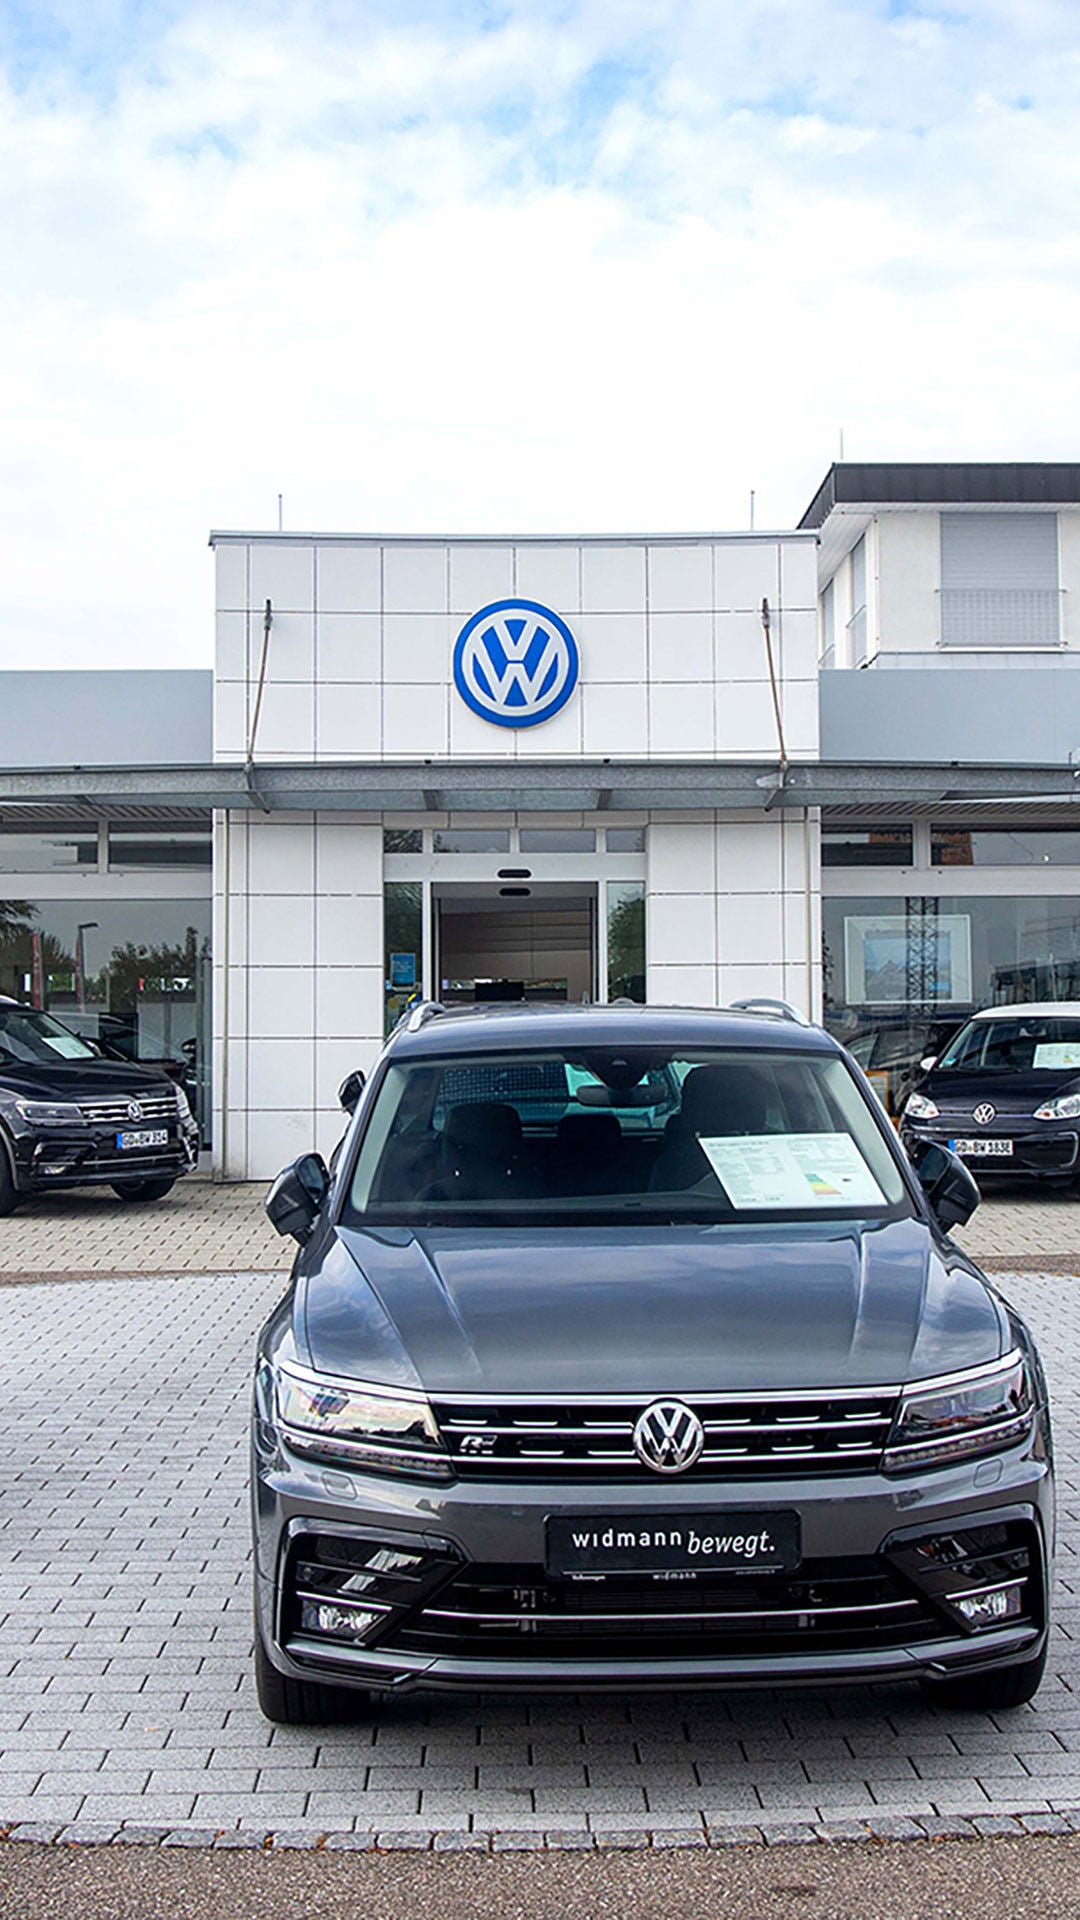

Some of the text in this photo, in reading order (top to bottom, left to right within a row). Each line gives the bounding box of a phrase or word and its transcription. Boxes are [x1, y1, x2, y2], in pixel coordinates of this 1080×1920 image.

[461, 608, 570, 717] VW
[633, 1401, 704, 1473] VW
[572, 1528, 776, 1559] widmann bewegt.
